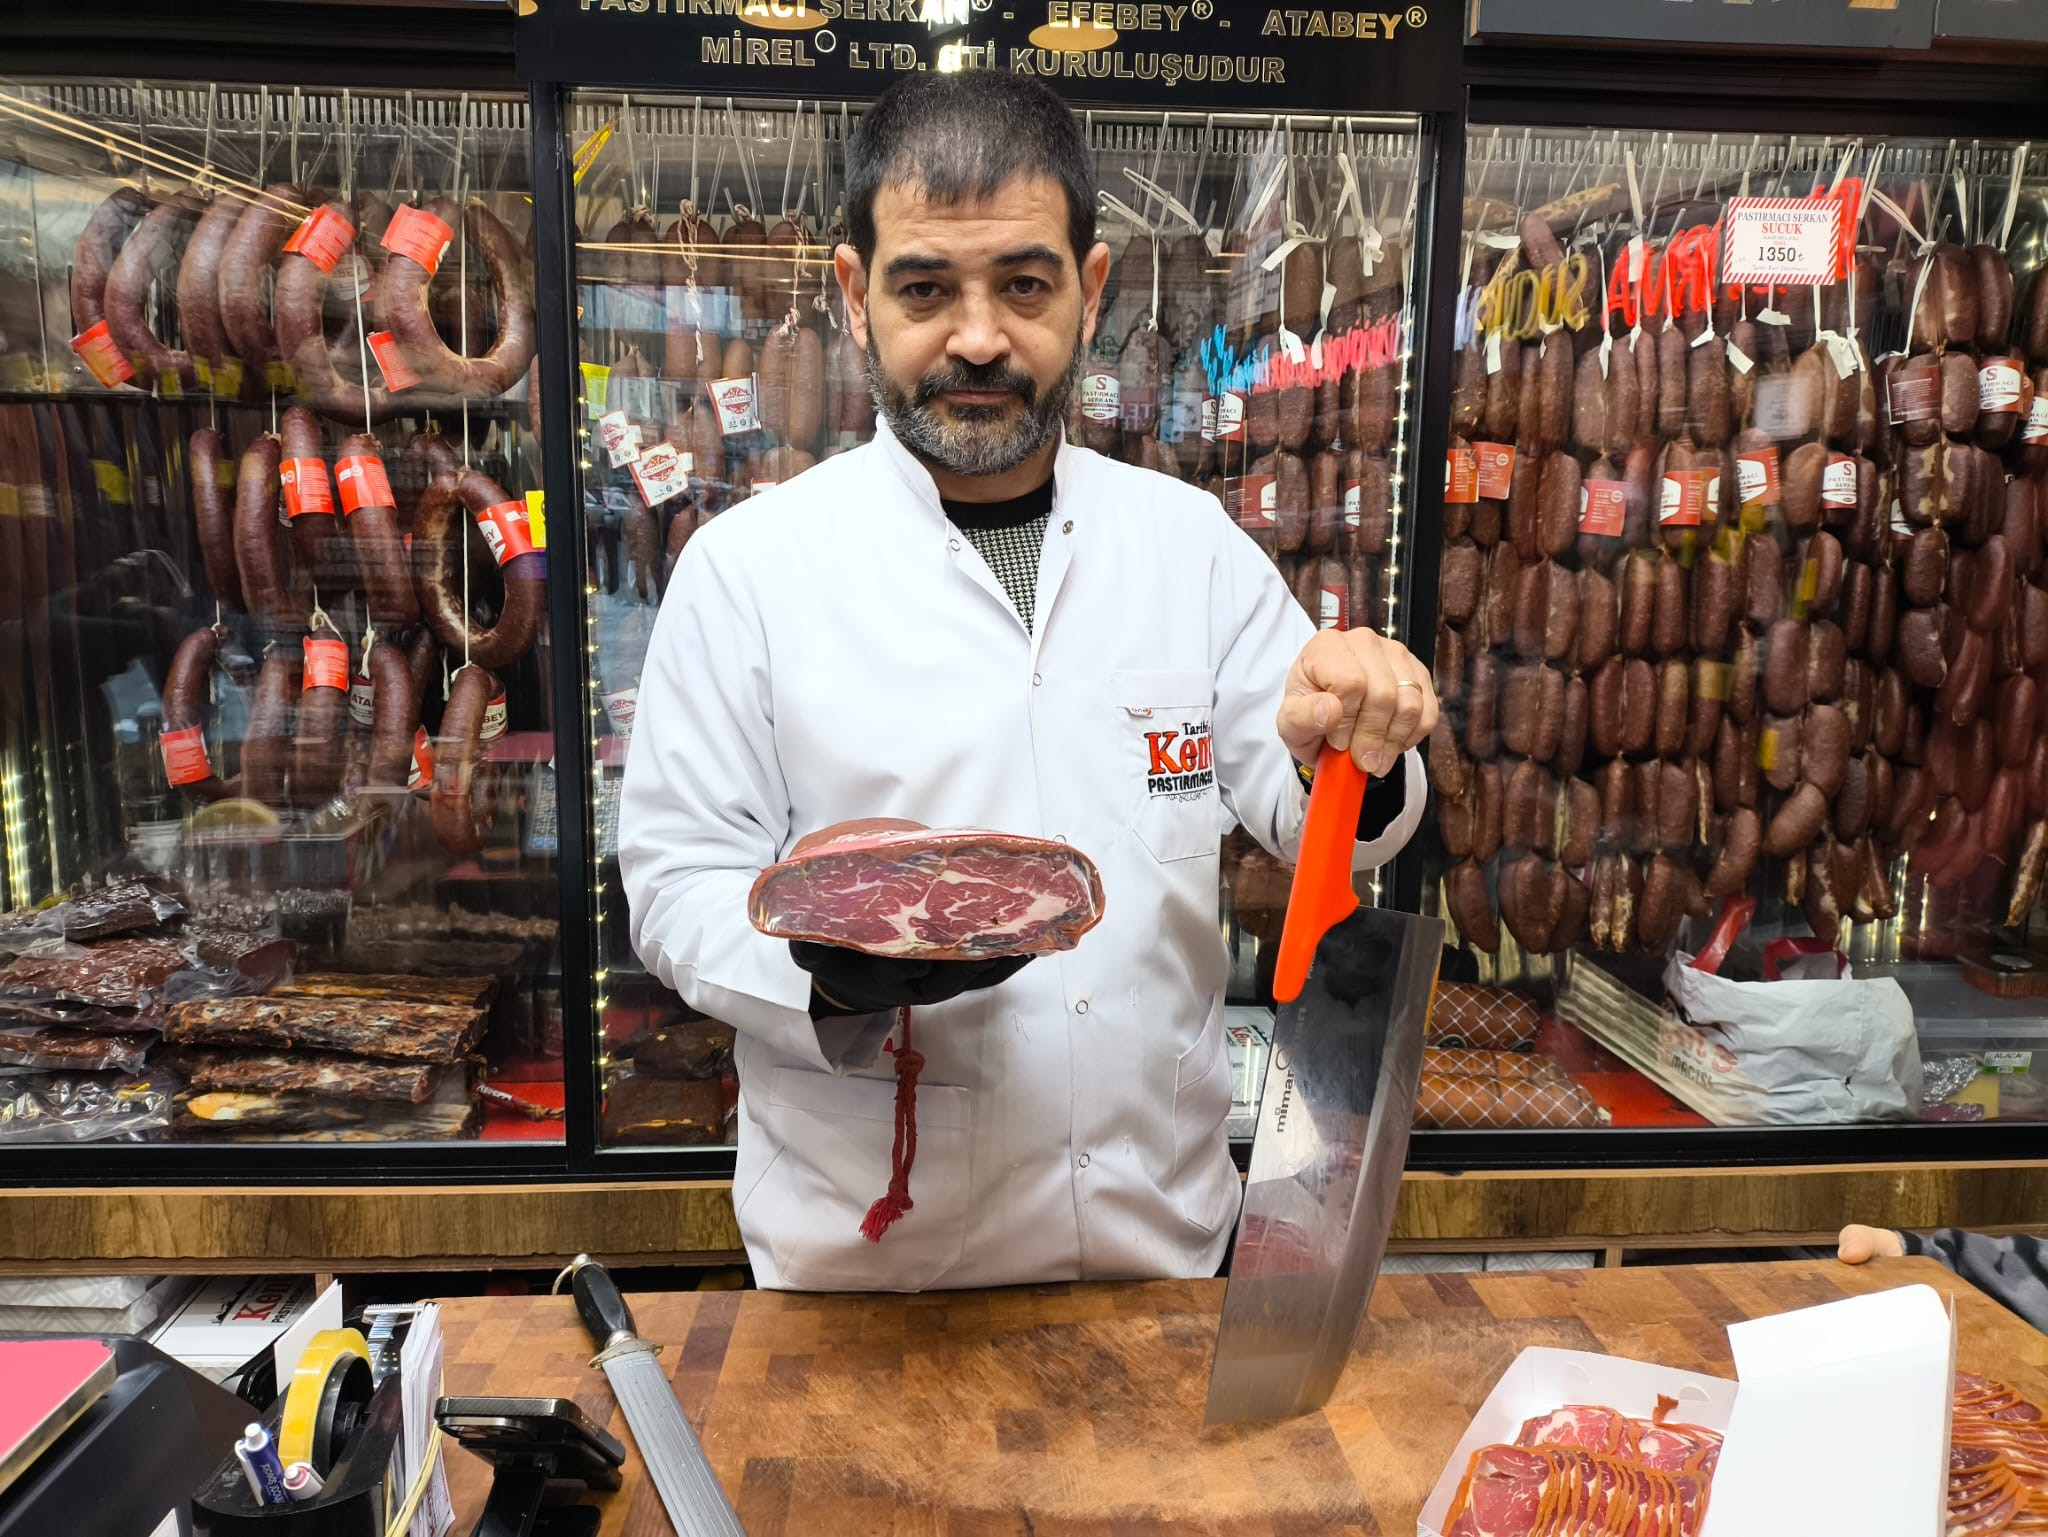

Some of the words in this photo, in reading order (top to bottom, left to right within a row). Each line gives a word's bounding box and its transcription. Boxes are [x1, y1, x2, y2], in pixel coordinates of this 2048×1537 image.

[849, 42, 926, 70] LTD.
[1010, 48, 1286, 87] KURULUŞUDUR
[1737, 211, 1792, 222] PASTIRMACI
[1792, 213, 1829, 223] SERKAN
[1761, 222, 1803, 235] SUCUK
